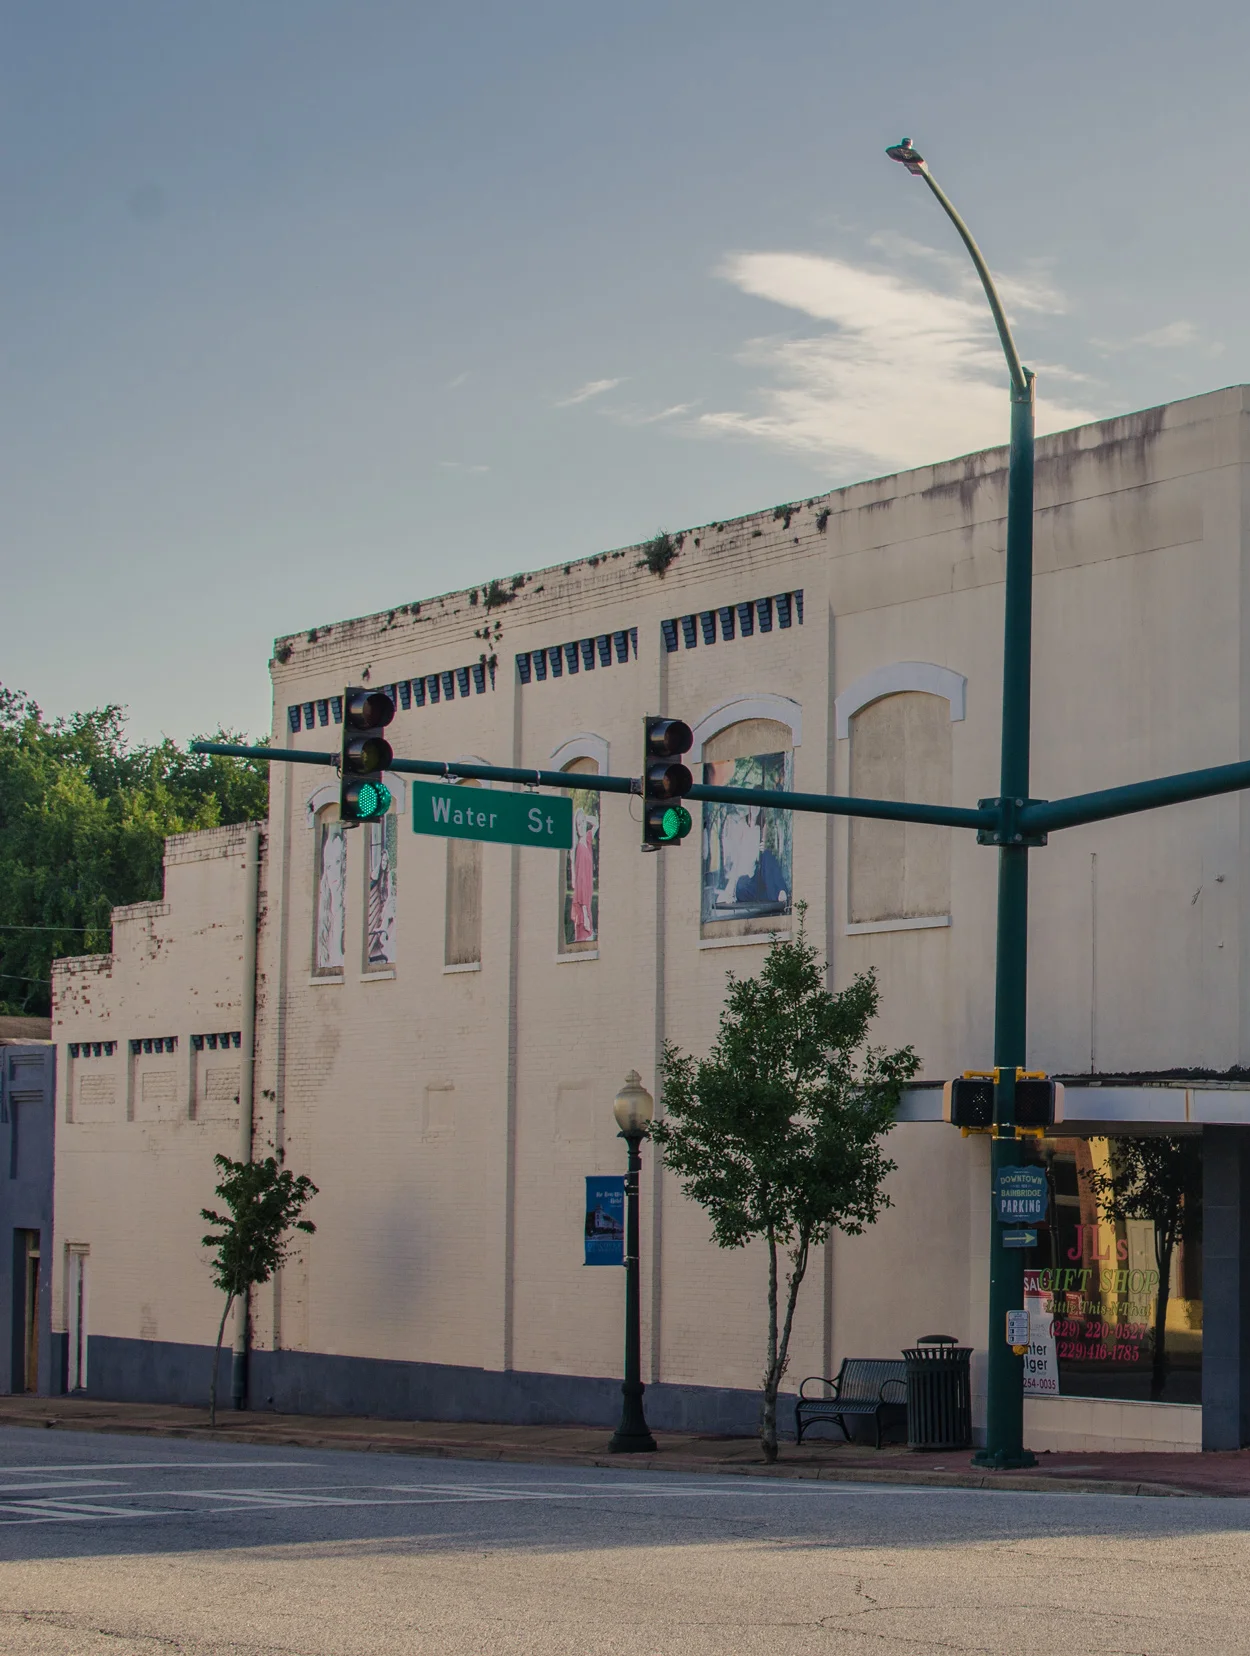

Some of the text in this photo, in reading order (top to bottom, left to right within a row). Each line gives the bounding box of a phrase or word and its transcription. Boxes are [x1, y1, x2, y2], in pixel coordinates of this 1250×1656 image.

[432, 796, 554, 835] Water St
[1000, 1175, 1043, 1185] DOWNTOWN
[1001, 1189, 1042, 1197] BAINBRIDGE
[1001, 1199, 1041, 1213] PARKING
[1067, 1224, 1128, 1261] JL's
[1039, 1267, 1160, 1294] GIFT SHOP
[1045, 1299, 1076, 1314] Little
[1049, 1320, 1080, 1339] (229)
[1085, 1321, 1148, 1340] 220-0527
[1056, 1341, 1140, 1362] (229)416-1785
[1024, 1356, 1048, 1373] lger
